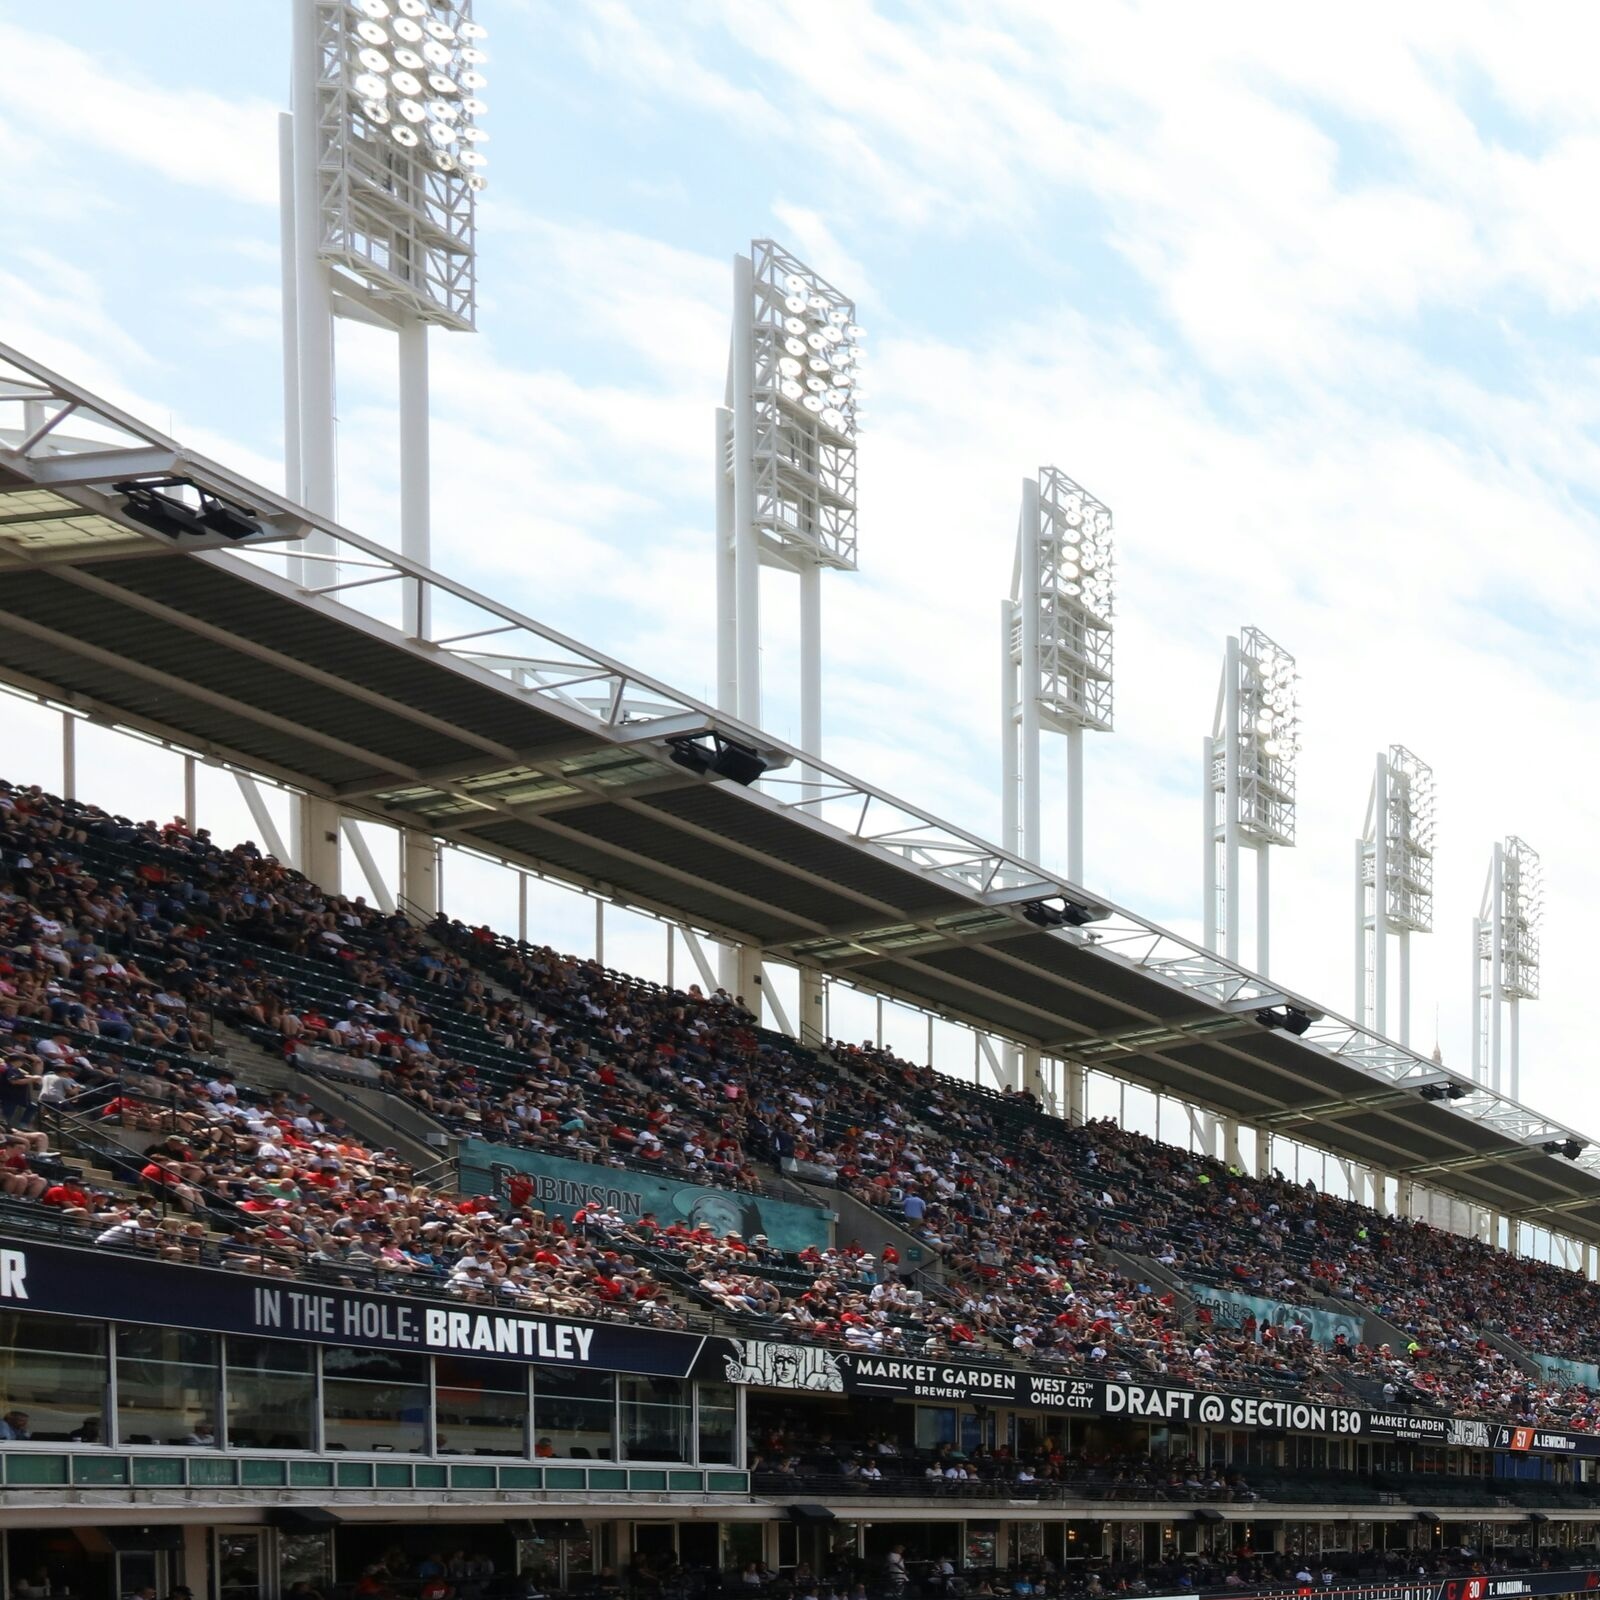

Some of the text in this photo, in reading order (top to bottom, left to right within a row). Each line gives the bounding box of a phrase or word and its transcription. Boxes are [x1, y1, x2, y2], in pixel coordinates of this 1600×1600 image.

[255, 1288, 594, 1361] IN THE HOLE: BRANTLEY
[857, 1359, 1016, 1390] MARKET GARDEN
[915, 1385, 967, 1399] BREWERY
[1031, 1376, 1067, 1393] WEST
[1030, 1391, 1094, 1409] OHIO CITY
[1105, 1384, 1362, 1434] DRAFT @ SECTION 130
[1370, 1414, 1444, 1432] MARKET GARDEN
